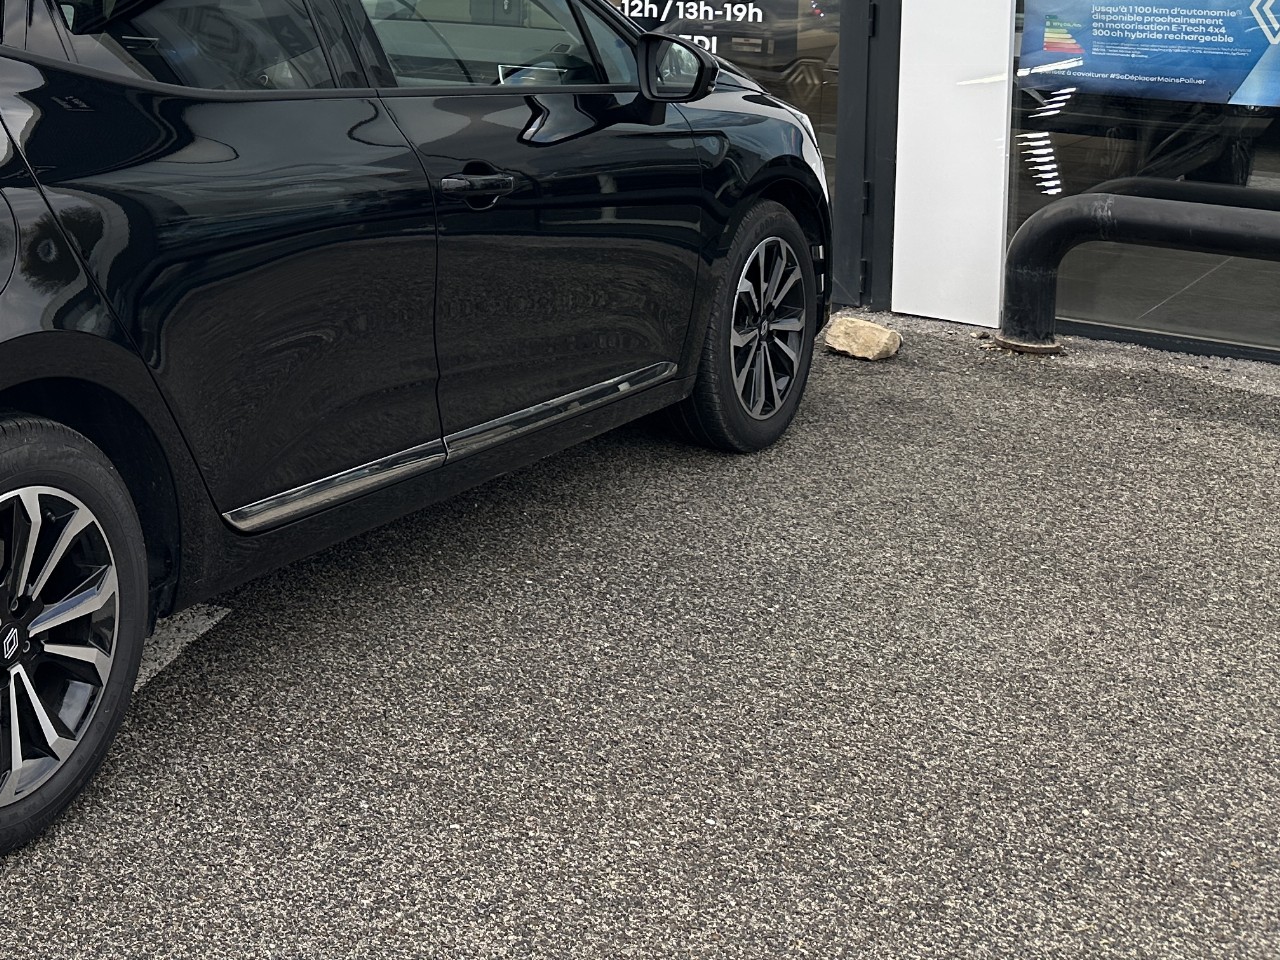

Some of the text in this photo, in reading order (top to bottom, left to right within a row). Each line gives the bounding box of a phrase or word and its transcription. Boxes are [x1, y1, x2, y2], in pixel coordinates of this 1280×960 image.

[676, 0, 763, 23] 13h-19h
[1153, 6, 1170, 14] km
[1092, 13, 1224, 26] disponible prochainement
[1106, 22, 1170, 31] motorisation
[1172, 25, 1206, 33] E-Tech
[1207, 26, 1227, 34] 4x4
[1124, 30, 1163, 40] hybride
[1164, 32, 1234, 43] rechargeable
